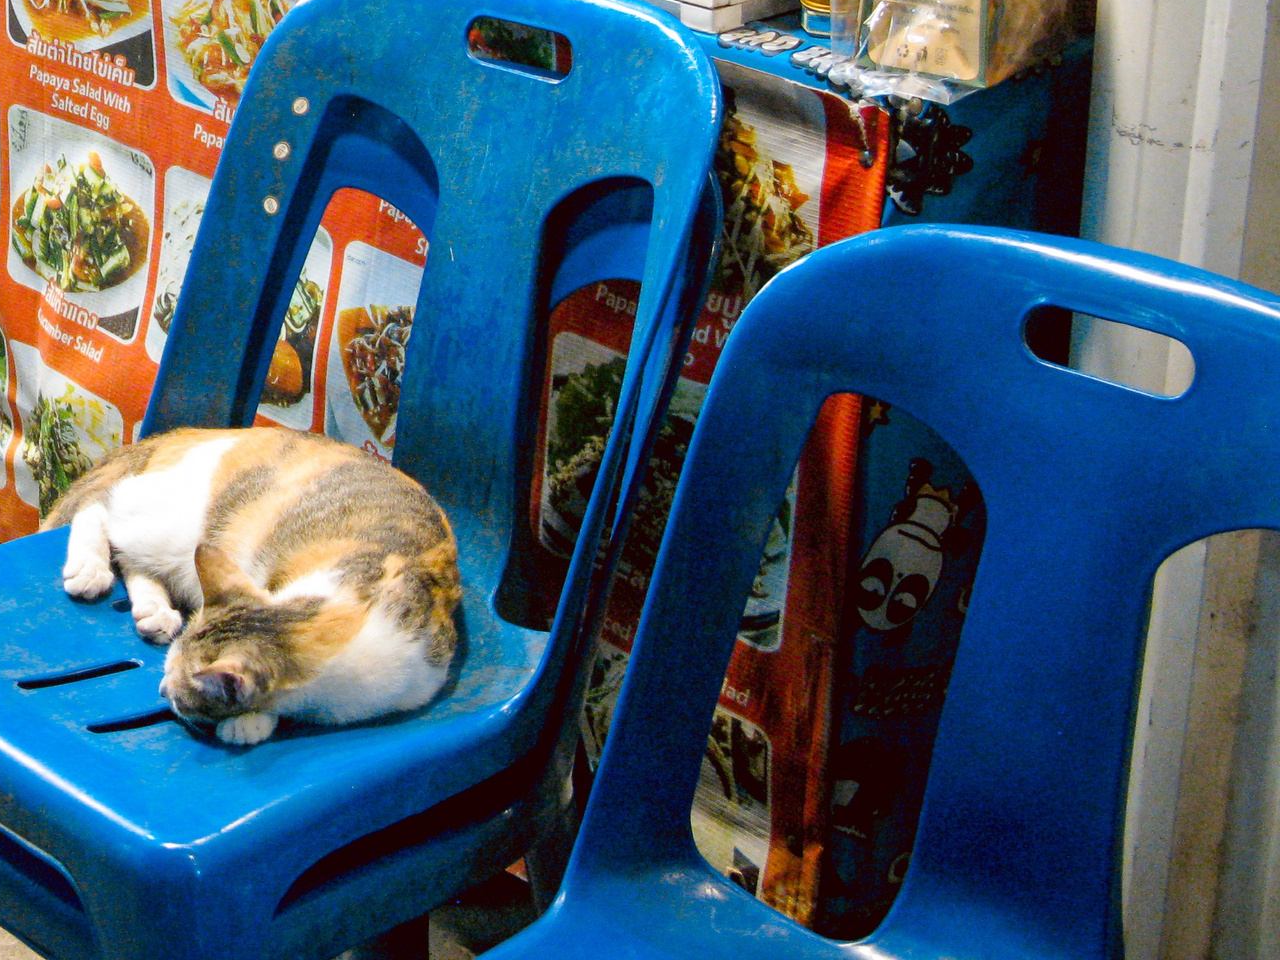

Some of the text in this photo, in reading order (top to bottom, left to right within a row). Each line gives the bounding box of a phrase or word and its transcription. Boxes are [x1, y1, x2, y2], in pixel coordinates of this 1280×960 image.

[27, 30, 134, 87] ส้มตำไทยไข่เค็ม
[29, 64, 131, 114] Papaya Salad With
[51, 93, 110, 130] Salted Egg
[193, 123, 226, 149] Papa
[74, 335, 104, 364] Salad
